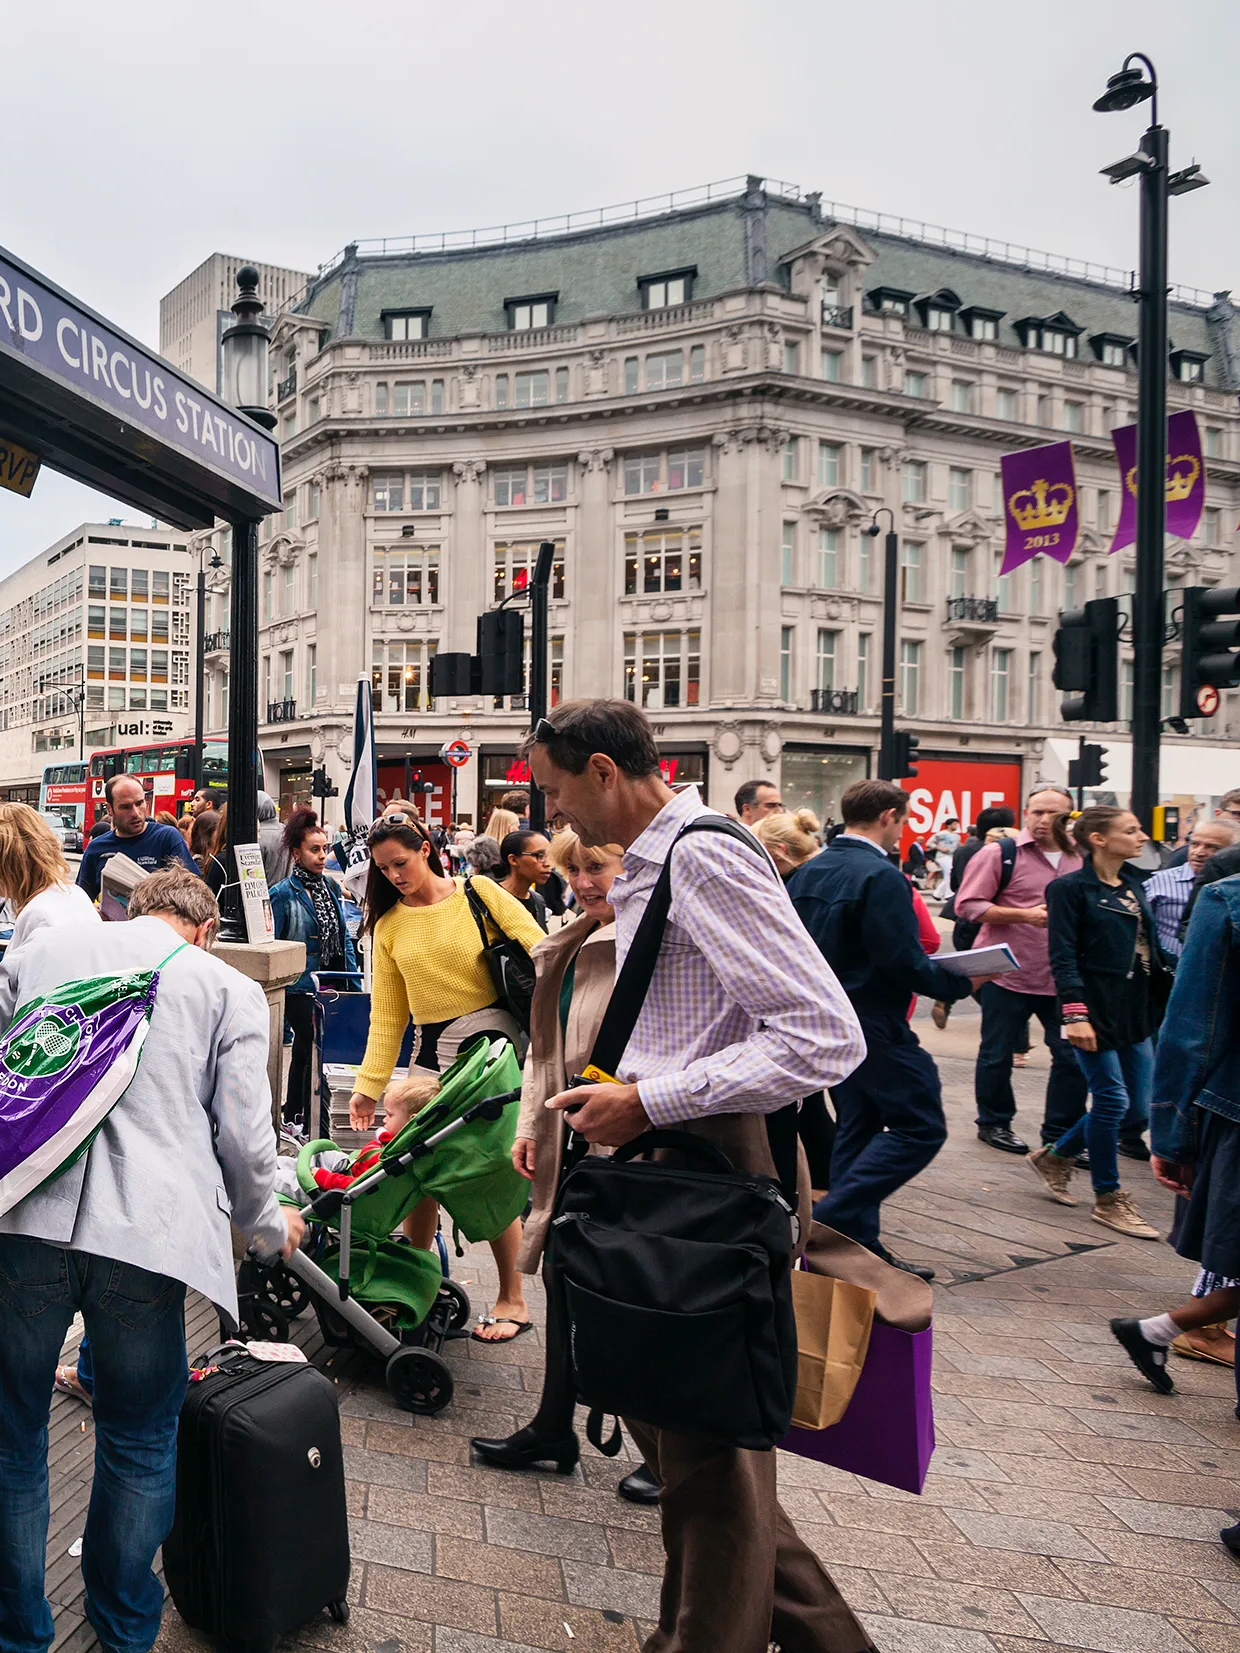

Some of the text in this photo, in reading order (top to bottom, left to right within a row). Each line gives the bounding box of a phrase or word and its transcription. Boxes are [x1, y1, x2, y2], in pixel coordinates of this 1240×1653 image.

[56, 316, 167, 421] CIRCUS
[176, 391, 268, 482] STATION
[1023, 533, 1060, 550] 2013
[118, 720, 149, 736] ual:
